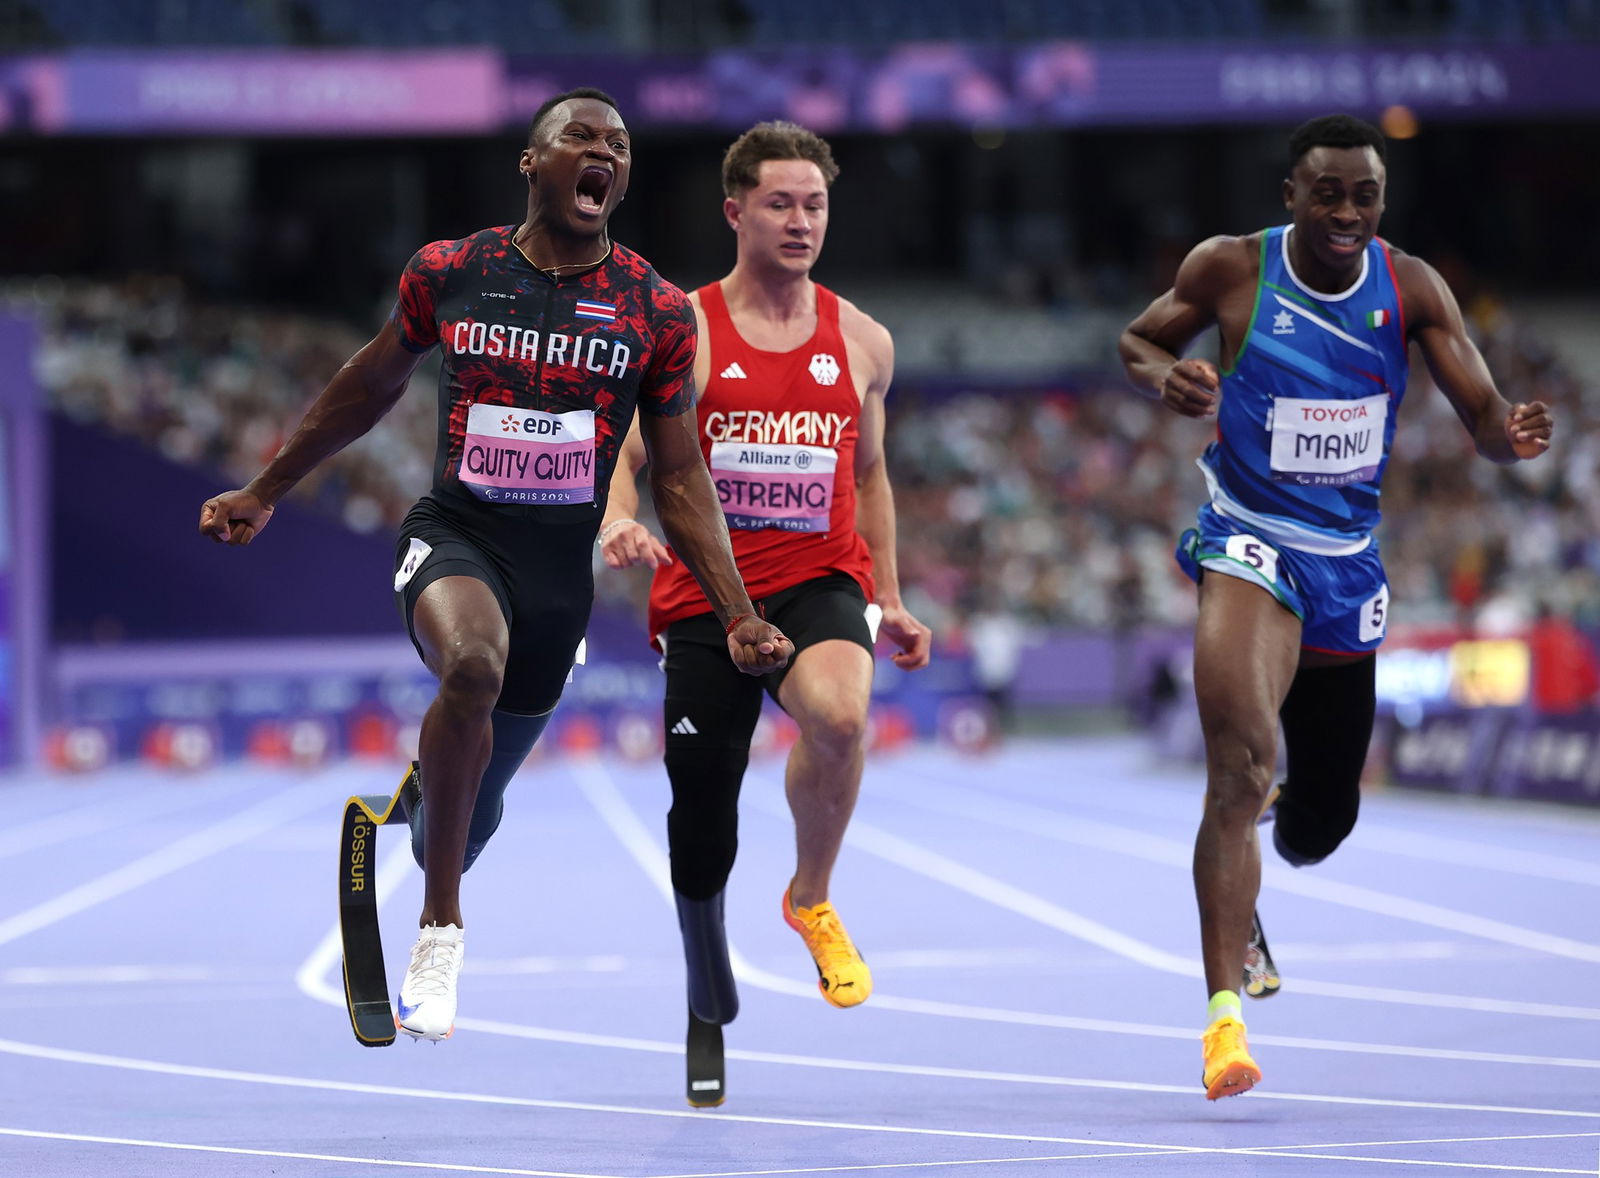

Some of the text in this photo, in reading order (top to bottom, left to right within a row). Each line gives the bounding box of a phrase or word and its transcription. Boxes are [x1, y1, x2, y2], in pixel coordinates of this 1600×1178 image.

[454, 322, 631, 380] COSTA RICA
[704, 410, 852, 446] GERMANY
[1300, 405, 1368, 422] TOYOTA
[738, 451, 791, 466] Allianz
[1294, 428, 1371, 460] MANU
[466, 445, 593, 480] GUITY GUITY
[505, 492, 570, 501] PARIS 2024
[716, 478, 826, 509] STRENG
[1243, 543, 1264, 569] 5
[1371, 599, 1384, 628] 5
[351, 825, 370, 891] ÖSSUR
